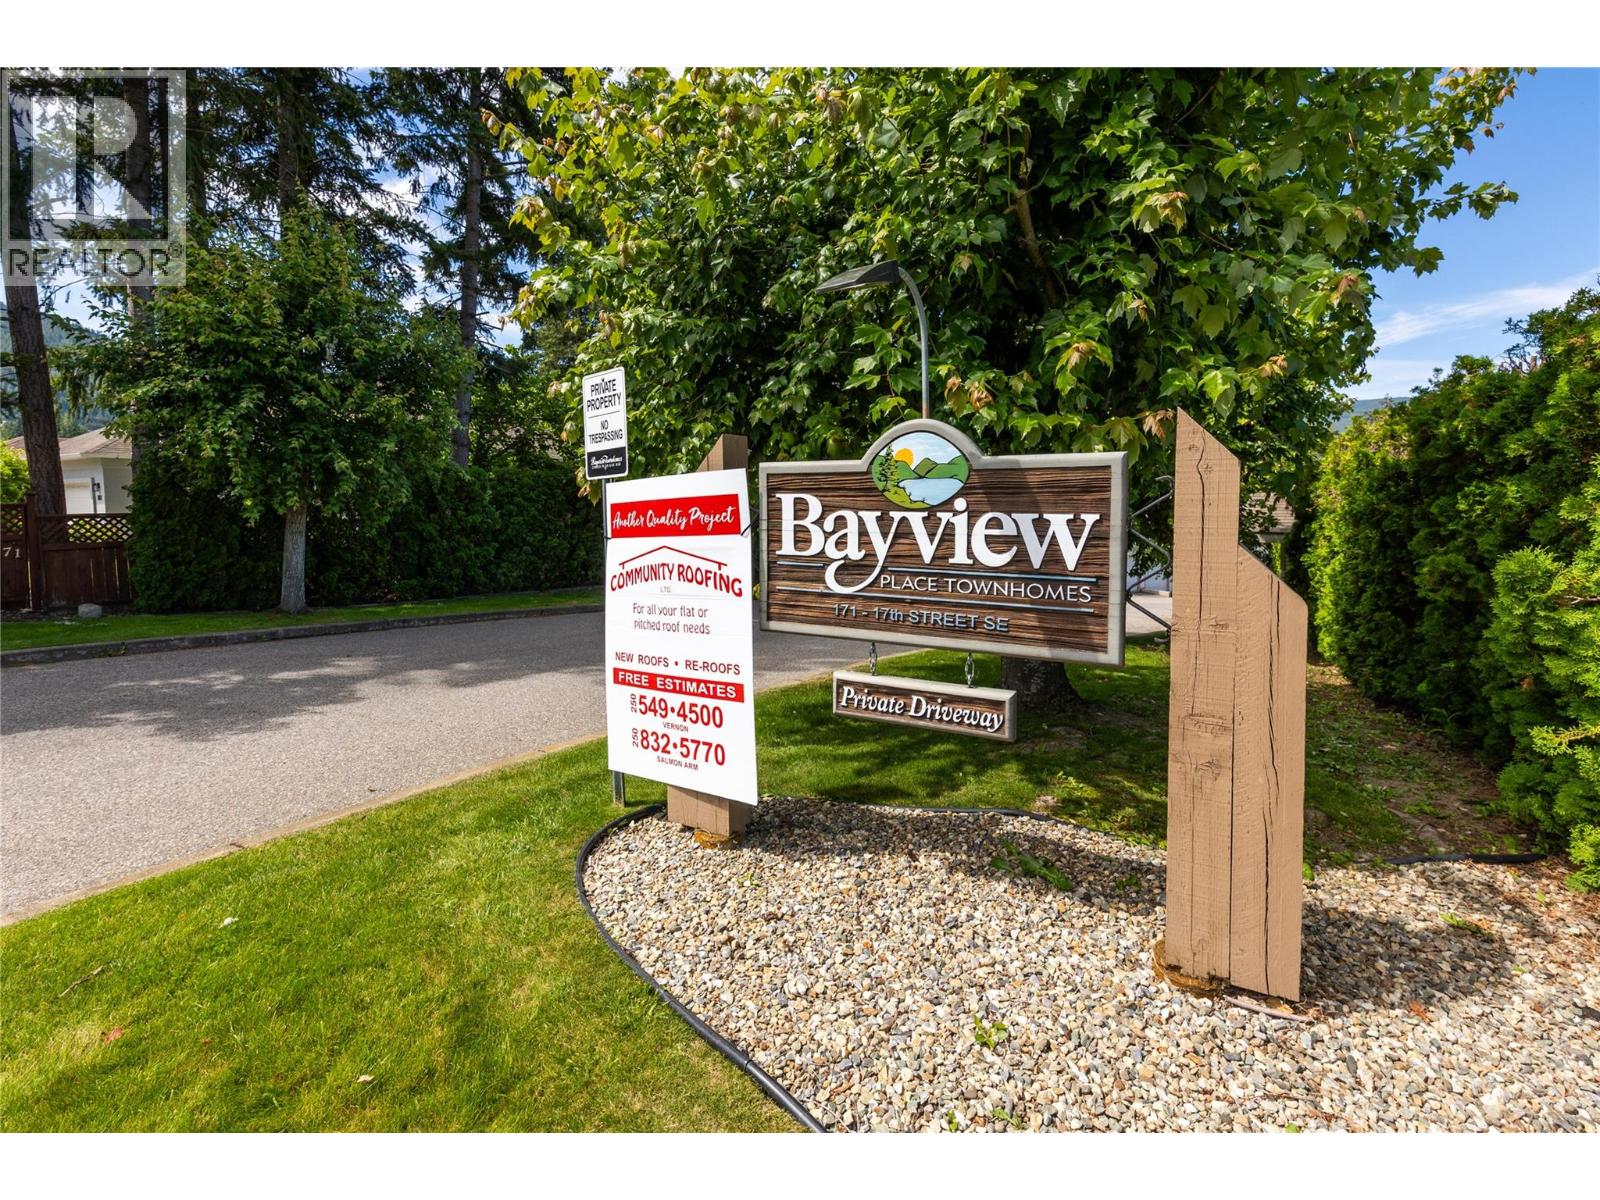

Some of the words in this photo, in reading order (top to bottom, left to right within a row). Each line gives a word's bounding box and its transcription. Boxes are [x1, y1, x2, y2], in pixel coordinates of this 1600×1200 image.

[591, 379, 616, 397] PRIVATE
[587, 392, 621, 412] PROPERTY
[600, 420, 608, 430] NO
[588, 429, 623, 444] TRESPASSING
[613, 512, 644, 528] Another
[646, 509, 687, 530] Quality
[688, 506, 736, 532] Project
[775, 493, 1100, 594] Bayview
[610, 563, 674, 592] COMMUNITY
[677, 564, 743, 597] ROOFING
[880, 575, 937, 593] PLACE
[944, 578, 1092, 602] TOWNHOMES
[633, 603, 645, 614] For
[647, 604, 656, 615] all
[658, 606, 677, 619] your
[680, 606, 694, 617] flat
[698, 608, 708, 618] or
[832, 604, 857, 618] 171
[874, 607, 904, 622] 17th
[909, 610, 978, 629] STREET
[983, 616, 1009, 632] SE
[634, 620, 660, 631] pitched
[662, 621, 680, 632] roof
[684, 623, 710, 635] needs
[615, 651, 634, 662] NEW
[638, 654, 669, 667] ROOFS
[685, 659, 740, 674] RE-ROOFS
[618, 671, 649, 686] FREE
[656, 677, 736, 698] ESTIMATES
[840, 686, 904, 714] Private
[908, 695, 1003, 732] Driveway
[663, 722, 689, 732] VERNON
[657, 756, 683, 767] SALMON
[684, 761, 699, 771] ARM
